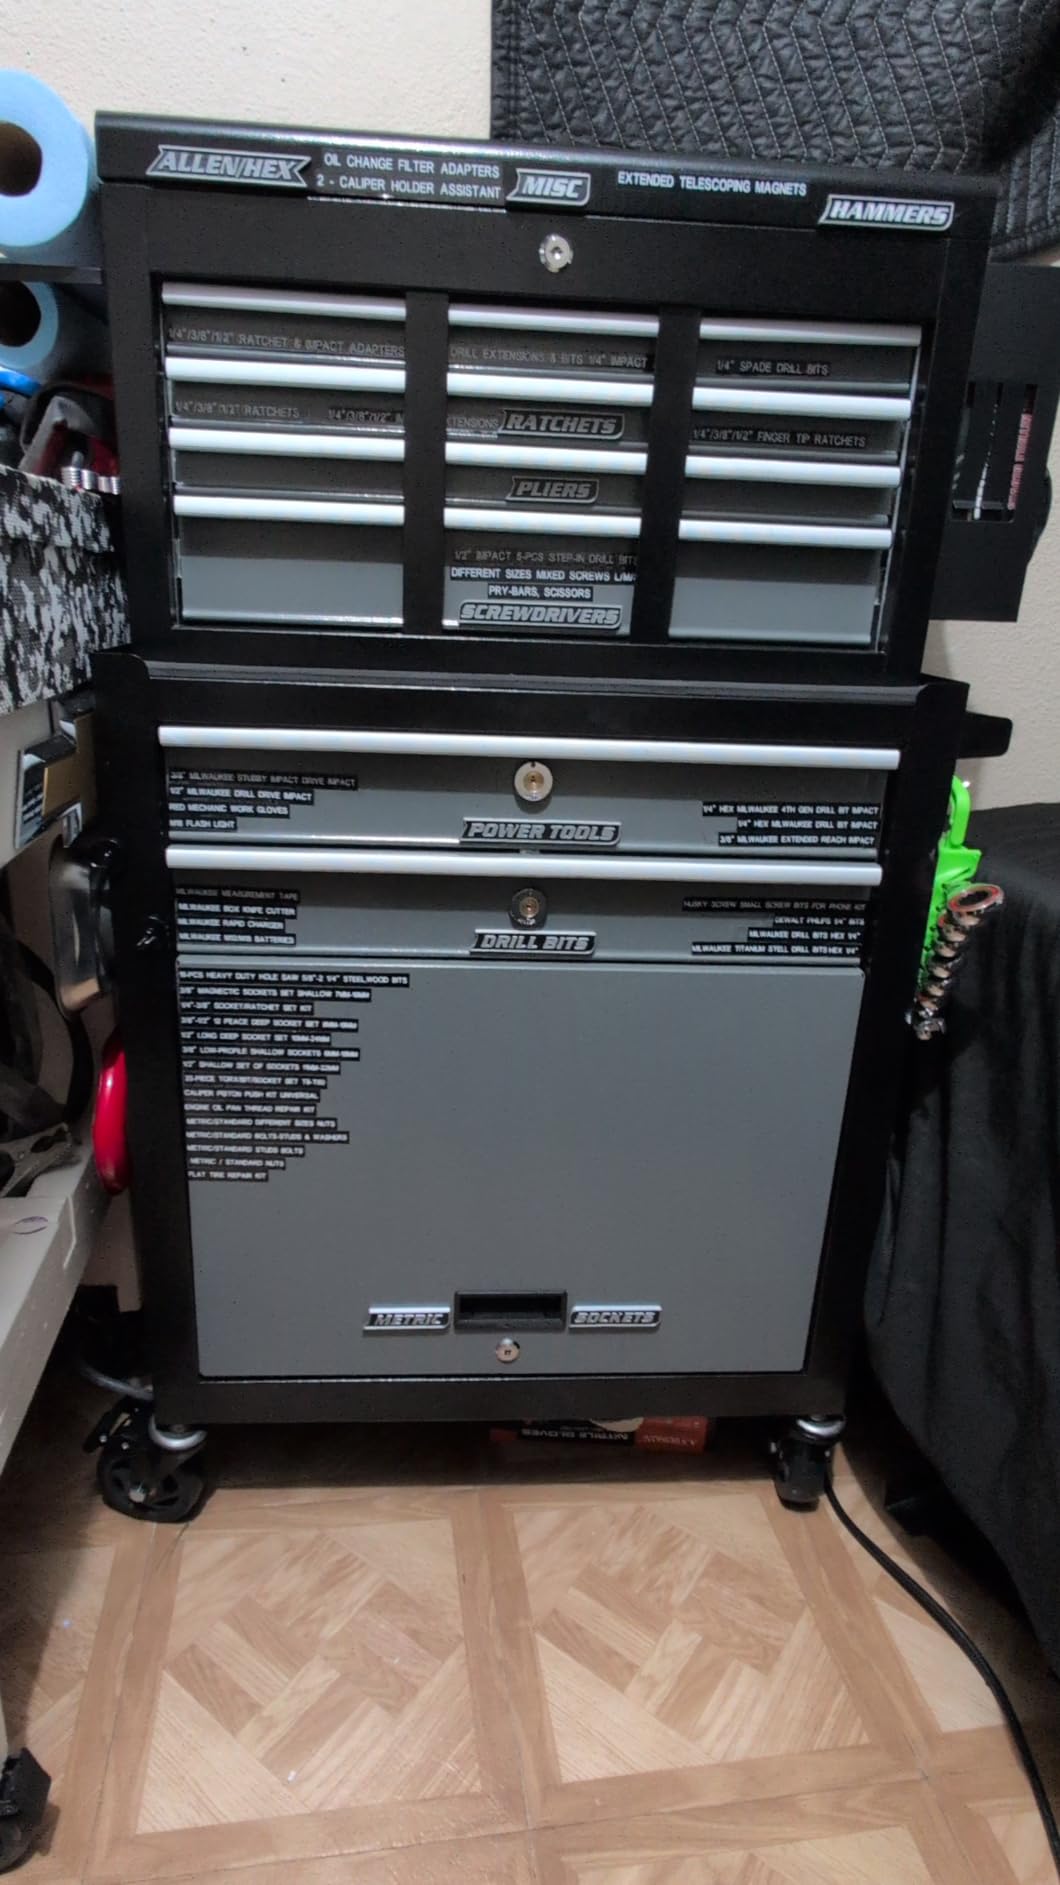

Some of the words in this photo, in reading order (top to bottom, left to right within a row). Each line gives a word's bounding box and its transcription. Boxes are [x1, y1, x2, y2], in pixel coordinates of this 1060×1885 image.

[158, 151, 296, 179] ALLEN/HEX
[324, 153, 342, 166] OIL
[346, 155, 393, 170] CHANGE
[398, 158, 435, 174] FILTER
[440, 161, 501, 179] ADAPTERS
[316, 174, 324, 186] 2
[339, 175, 386, 191] CALIPER
[390, 181, 435, 195] HOLDER
[440, 183, 502, 199] ASSISTANT
[522, 176, 584, 198] MISC
[618, 171, 675, 187] EXTENDED
[679, 175, 751, 193] TELESCOPING
[754, 179, 807, 197] MAGNETS
[829, 201, 950, 224] HAMMERS
[239, 334, 288, 349] RATCHET
[304, 338, 345, 352] IMPACT
[349, 341, 405, 358] ADAPTERS
[610, 355, 648, 369] IMPACT
[739, 361, 772, 374] SPADE
[776, 362, 802, 375] DRILL
[806, 363, 829, 376] BITS
[243, 404, 300, 418] RATCHETS
[507, 413, 617, 434] RATCHETS
[756, 430, 791, 445] FINGER
[795, 432, 811, 445] TIP
[814, 432, 866, 448] RATCHETS
[516, 481, 592, 498] PLIERS
[475, 550, 512, 562] IMPACT
[588, 553, 614, 565] DRILL
[451, 567, 501, 579] DIFFERENT
[505, 567, 532, 580] SIZES
[535, 569, 566, 581] MIXED
[569, 570, 610, 582] SCREWS
[543, 587, 592, 599] SCISSORS
[461, 603, 620, 624] SCREWDRIVERS
[187, 787, 232, 798] MILWAUKEE
[283, 791, 312, 802] IMPACT
[256, 805, 289, 815] GLOVES
[719, 805, 734, 814] HEX
[736, 804, 778, 814] MILWAUKEE
[815, 806, 836, 815] DRILL
[851, 806, 879, 816] IMPACT
[185, 819, 211, 828] FLASH
[213, 820, 235, 829] LIGHT
[467, 822, 545, 839] POWER
[549, 825, 617, 841] TOOLS
[754, 819, 769, 829] HEX
[771, 820, 813, 829] MILWAUKEE
[815, 820, 834, 830] DRILL
[851, 820, 878, 830] IMPACT
[737, 834, 779, 844] MILWAUKEE
[780, 835, 819, 844] EXTENDED
[820, 835, 847, 845] REACH
[848, 835, 875, 846] IMPACT
[264, 906, 296, 916] CUTTER
[480, 934, 538, 949] DRILL
[542, 936, 590, 950] BITS
[749, 930, 789, 940] MILWAUKEE
[691, 944, 732, 953] MILWAUKEE
[374, 1313, 443, 1325] METRIC
[574, 1311, 656, 1324] SOCKETS
